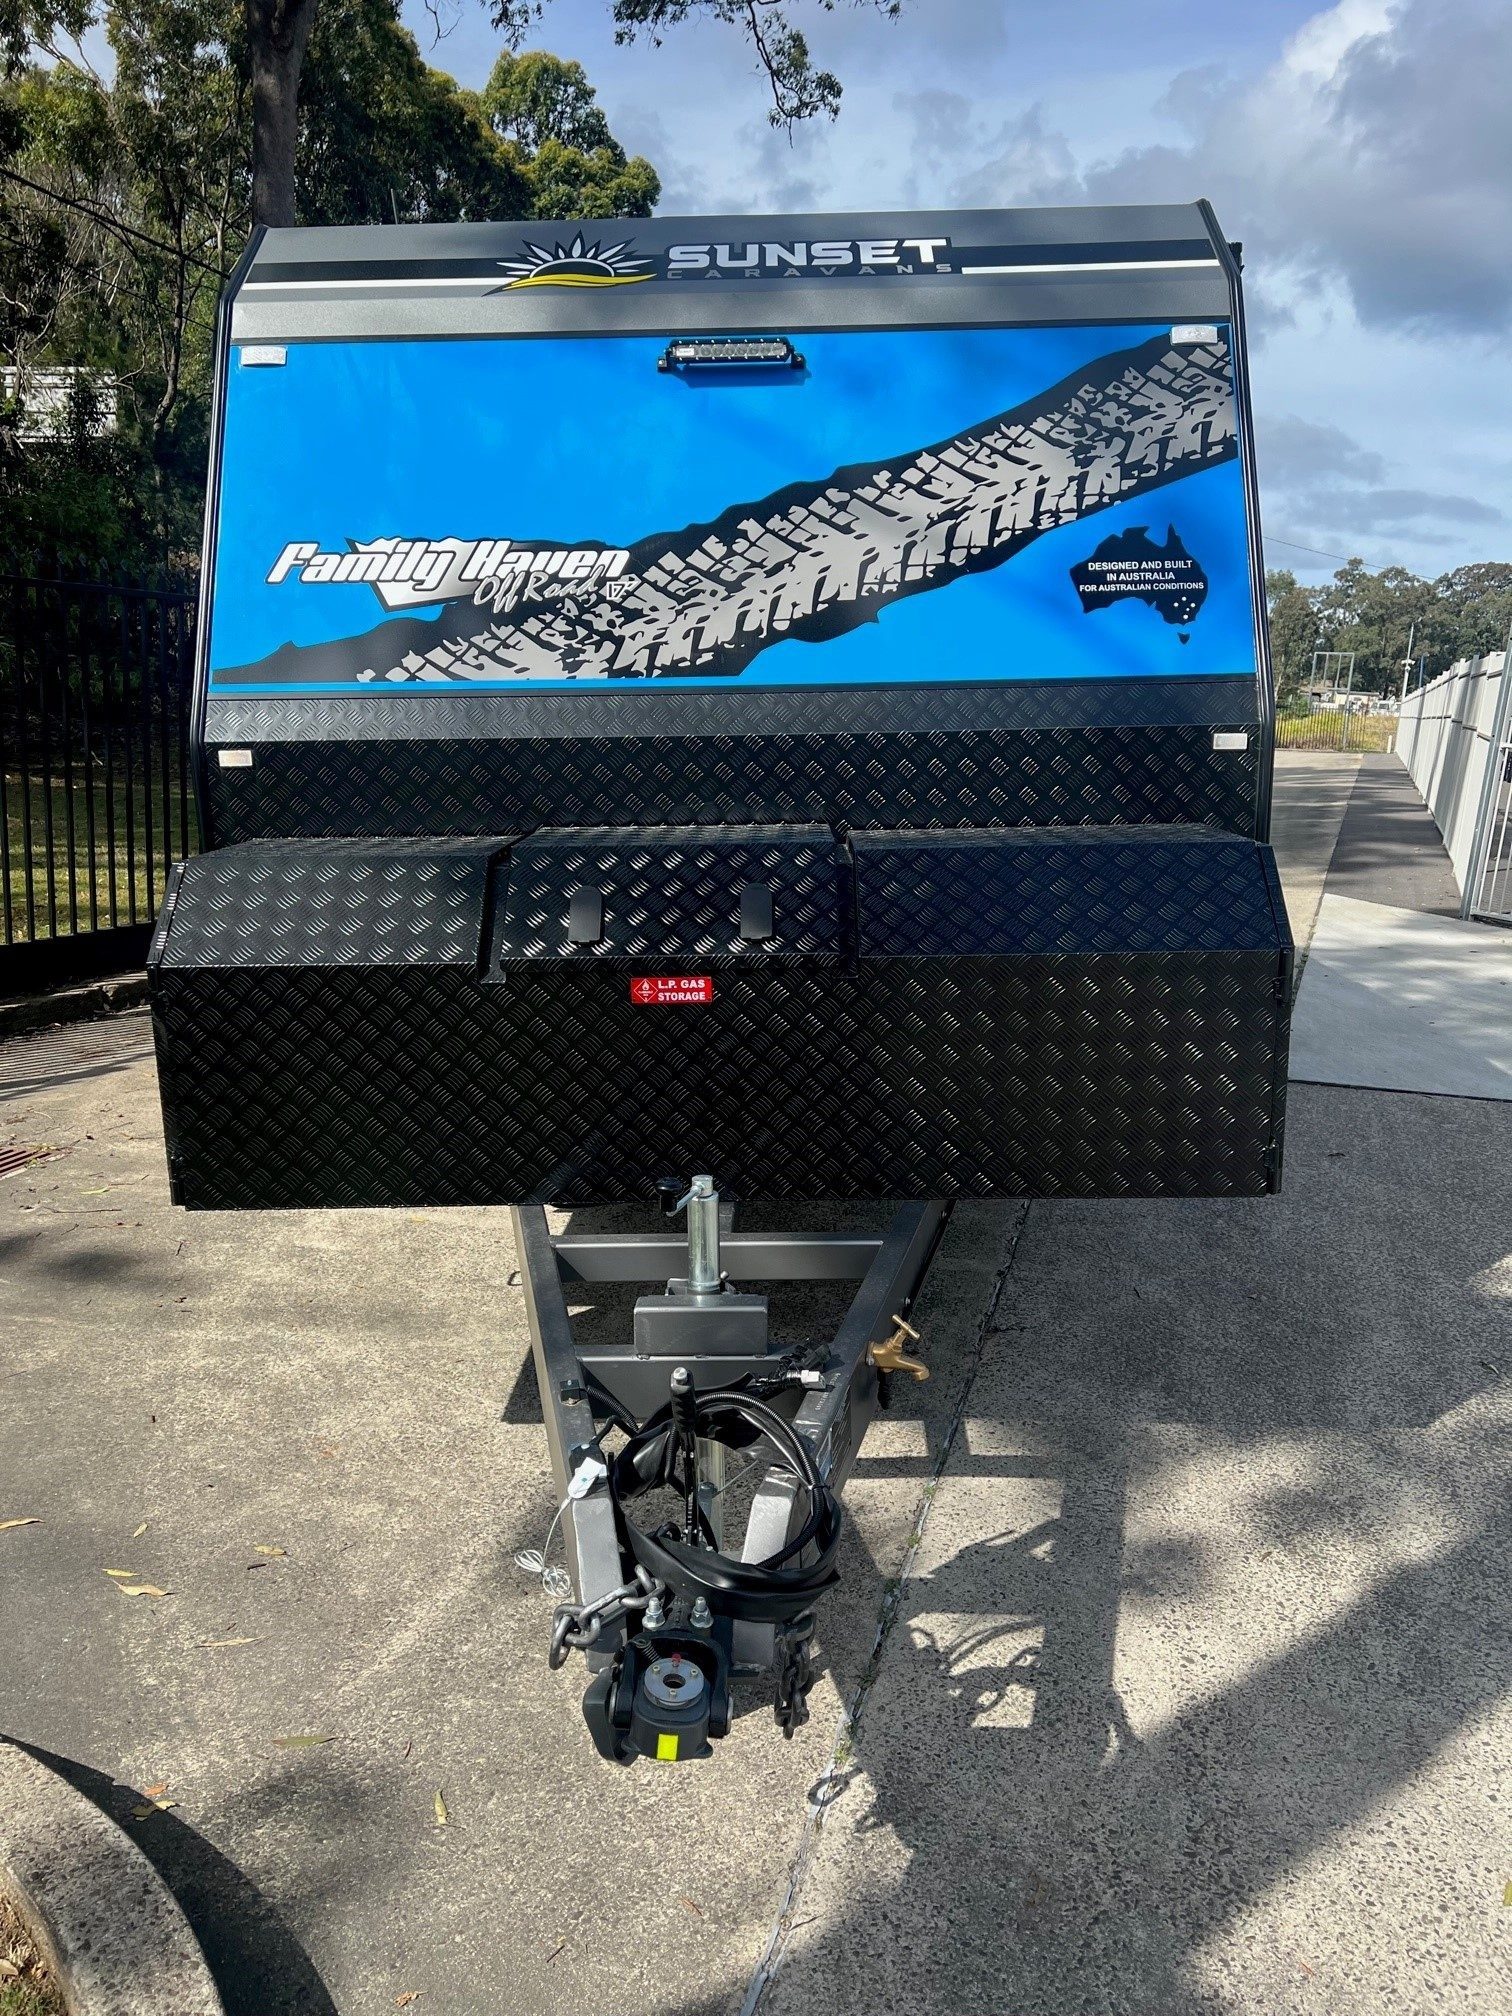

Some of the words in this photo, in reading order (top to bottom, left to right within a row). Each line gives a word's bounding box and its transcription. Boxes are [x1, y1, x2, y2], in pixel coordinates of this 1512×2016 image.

[668, 239, 947, 270] SUNSET
[667, 264, 953, 280] CARAVANS
[265, 540, 459, 591] Family
[461, 540, 631, 580] Haven
[1088, 561, 1139, 571] DESIGNED
[1141, 560, 1162, 569] AND
[1164, 560, 1193, 569] BUILT
[1106, 573, 1117, 582] IN
[1119, 571, 1175, 581] AUSTRALIA
[474, 571, 526, 614] Off
[522, 565, 605, 602] Road
[1080, 584, 1097, 592] FOR
[1098, 583, 1152, 592] AUSTRALIAN
[1153, 582, 1204, 591] CONDITIONS
[658, 980, 677, 989] L.P.
[680, 979, 706, 989] GAS
[658, 991, 706, 1001] STORAGE
